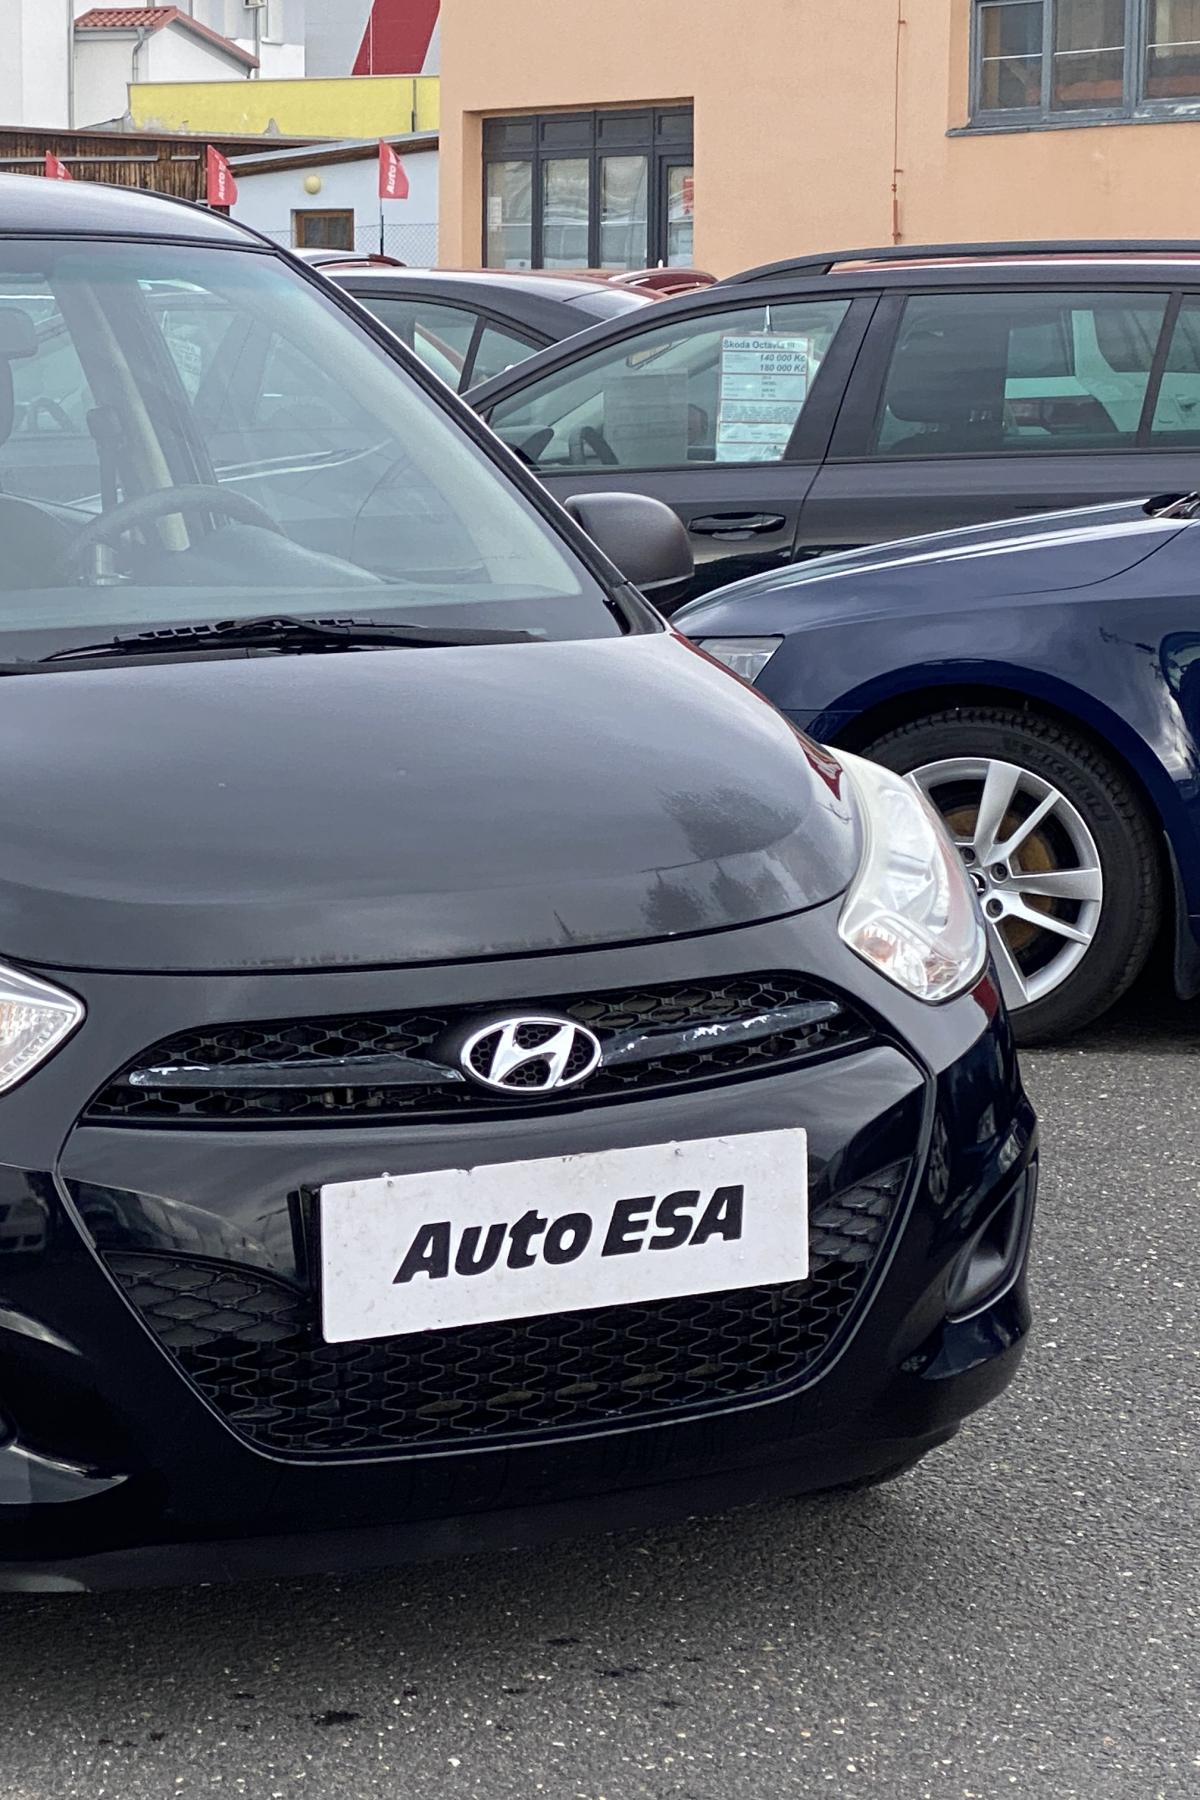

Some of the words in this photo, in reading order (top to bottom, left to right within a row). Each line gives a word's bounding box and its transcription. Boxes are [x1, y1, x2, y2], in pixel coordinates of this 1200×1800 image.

[752, 340, 785, 349] Octavia
[392, 1209, 592, 1285] Auto
[601, 1185, 744, 1258] ESA
